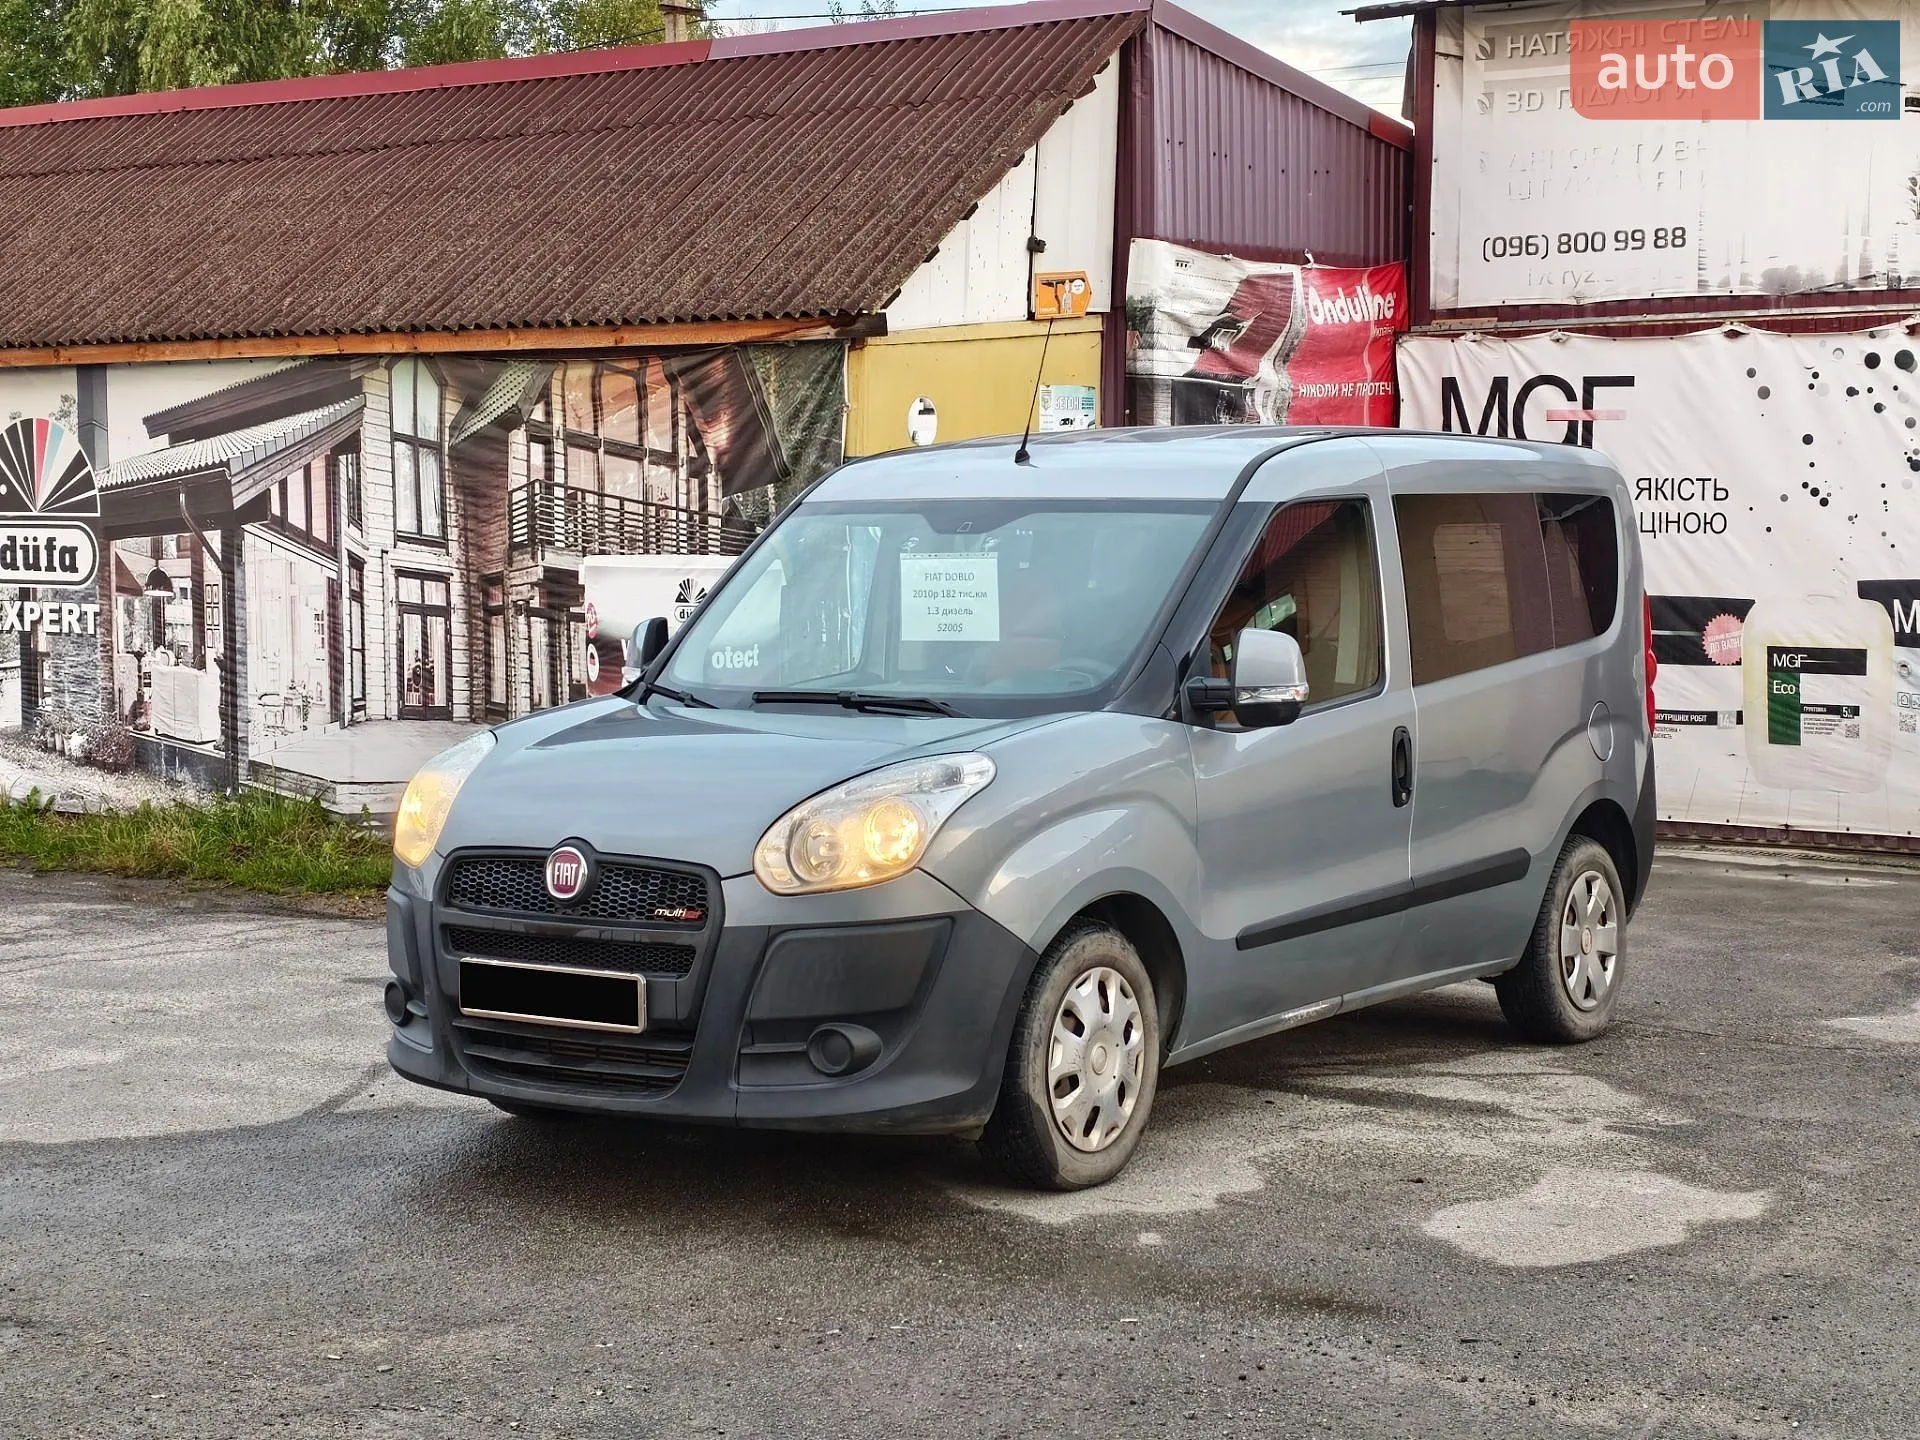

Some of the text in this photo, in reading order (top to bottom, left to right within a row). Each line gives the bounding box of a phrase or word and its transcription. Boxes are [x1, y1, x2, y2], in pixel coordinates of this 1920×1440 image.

[1507, 24, 1646, 58] НАТЯЖНІ
[1483, 226, 1686, 262] (096) 800 99 88
[1308, 285, 1395, 325] Onduline
[1299, 382, 1339, 398] НІКОЛИ
[1341, 382, 1354, 397] НЕ
[1441, 374, 1635, 449] MGF
[1635, 477, 1729, 501] ЯКІСТЬ
[1640, 511, 1728, 539] ЦІНОЮ
[0, 535, 79, 574] düfa
[924, 572, 975, 581] FIAT DOBLO
[913, 589, 988, 600] 2010р 182 тис.км
[0, 600, 100, 635] XPERT
[927, 606, 974, 617] 1.3 дизель
[937, 623, 964, 633] 5200$
[711, 643, 760, 669] otect
[1773, 653, 1808, 668] MGF
[1773, 680, 1796, 695] Eco
[554, 862, 579, 886] FIAT
